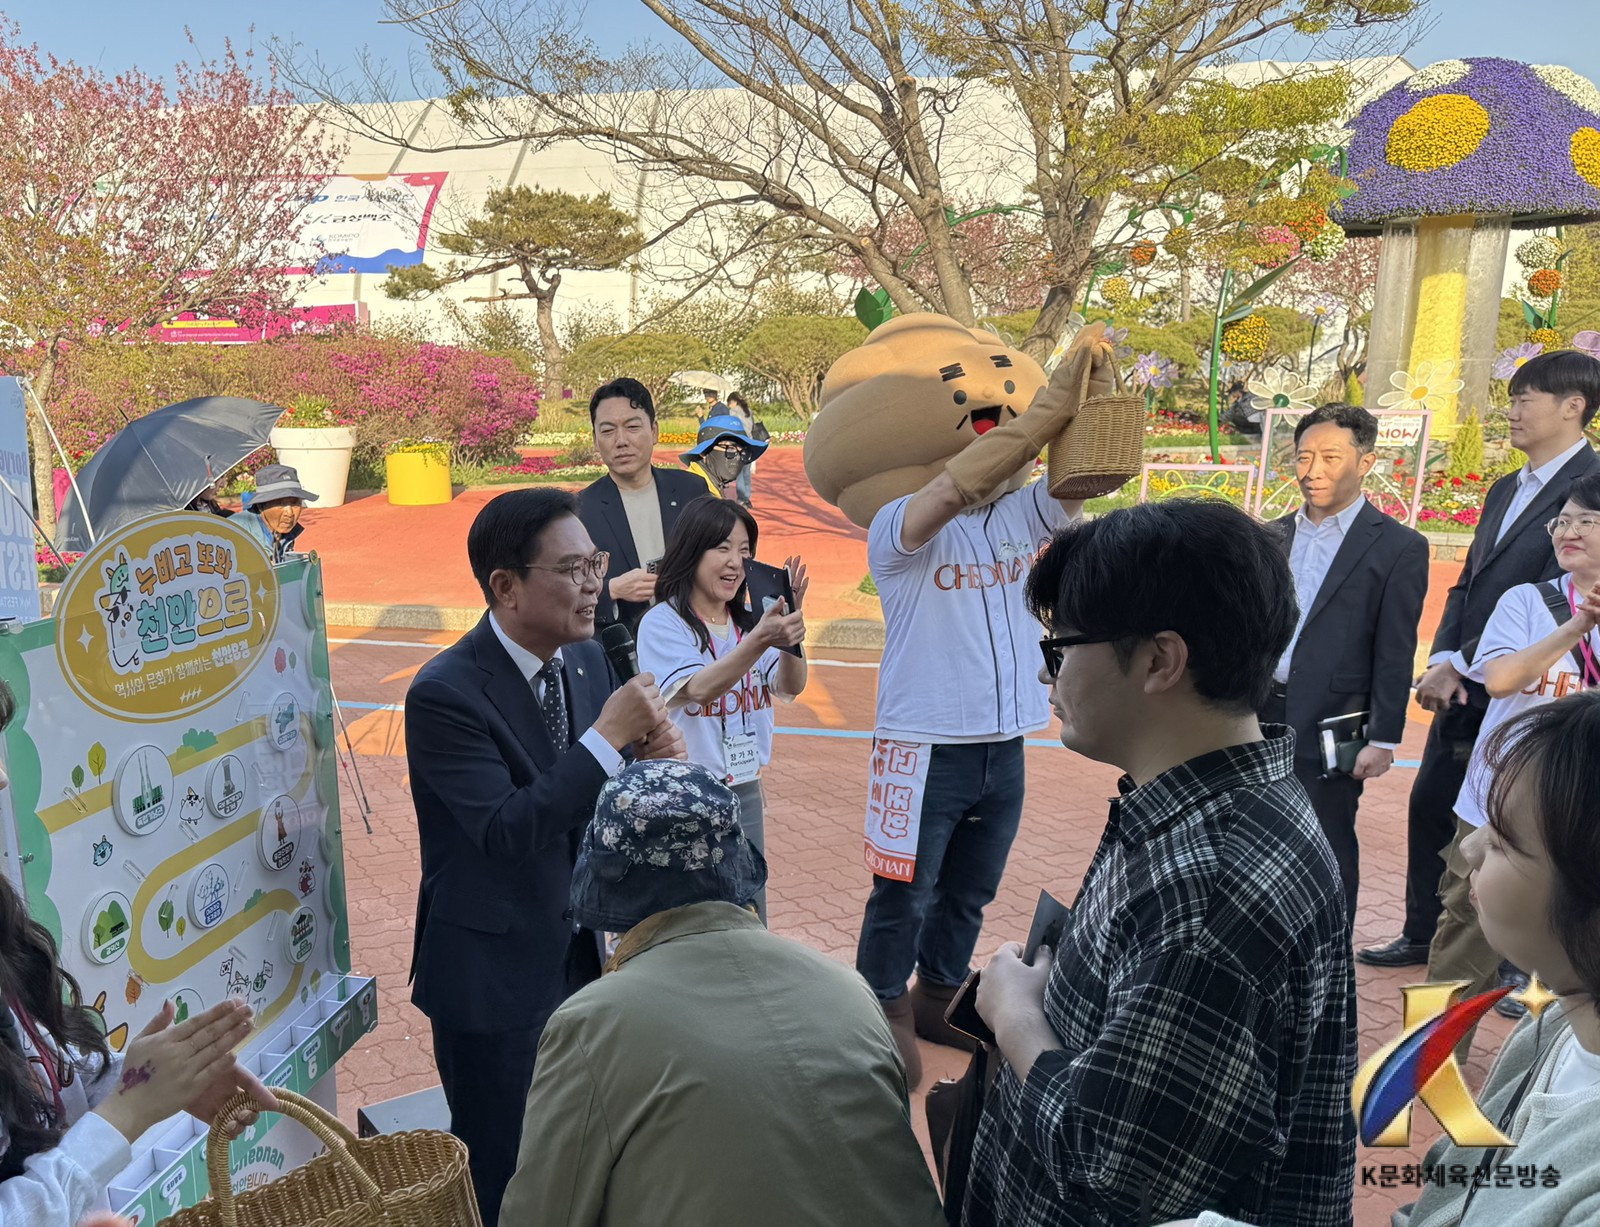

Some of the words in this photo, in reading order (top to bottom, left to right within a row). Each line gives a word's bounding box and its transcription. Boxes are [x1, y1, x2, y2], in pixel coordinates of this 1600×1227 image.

[135, 544, 194, 596] 누비고
[197, 541, 233, 580] 또와
[136, 579, 250, 654] 천안으로
[114, 676, 146, 698] 역사와
[175, 656, 212, 680] 함께하는
[730, 757, 755, 768] Participant
